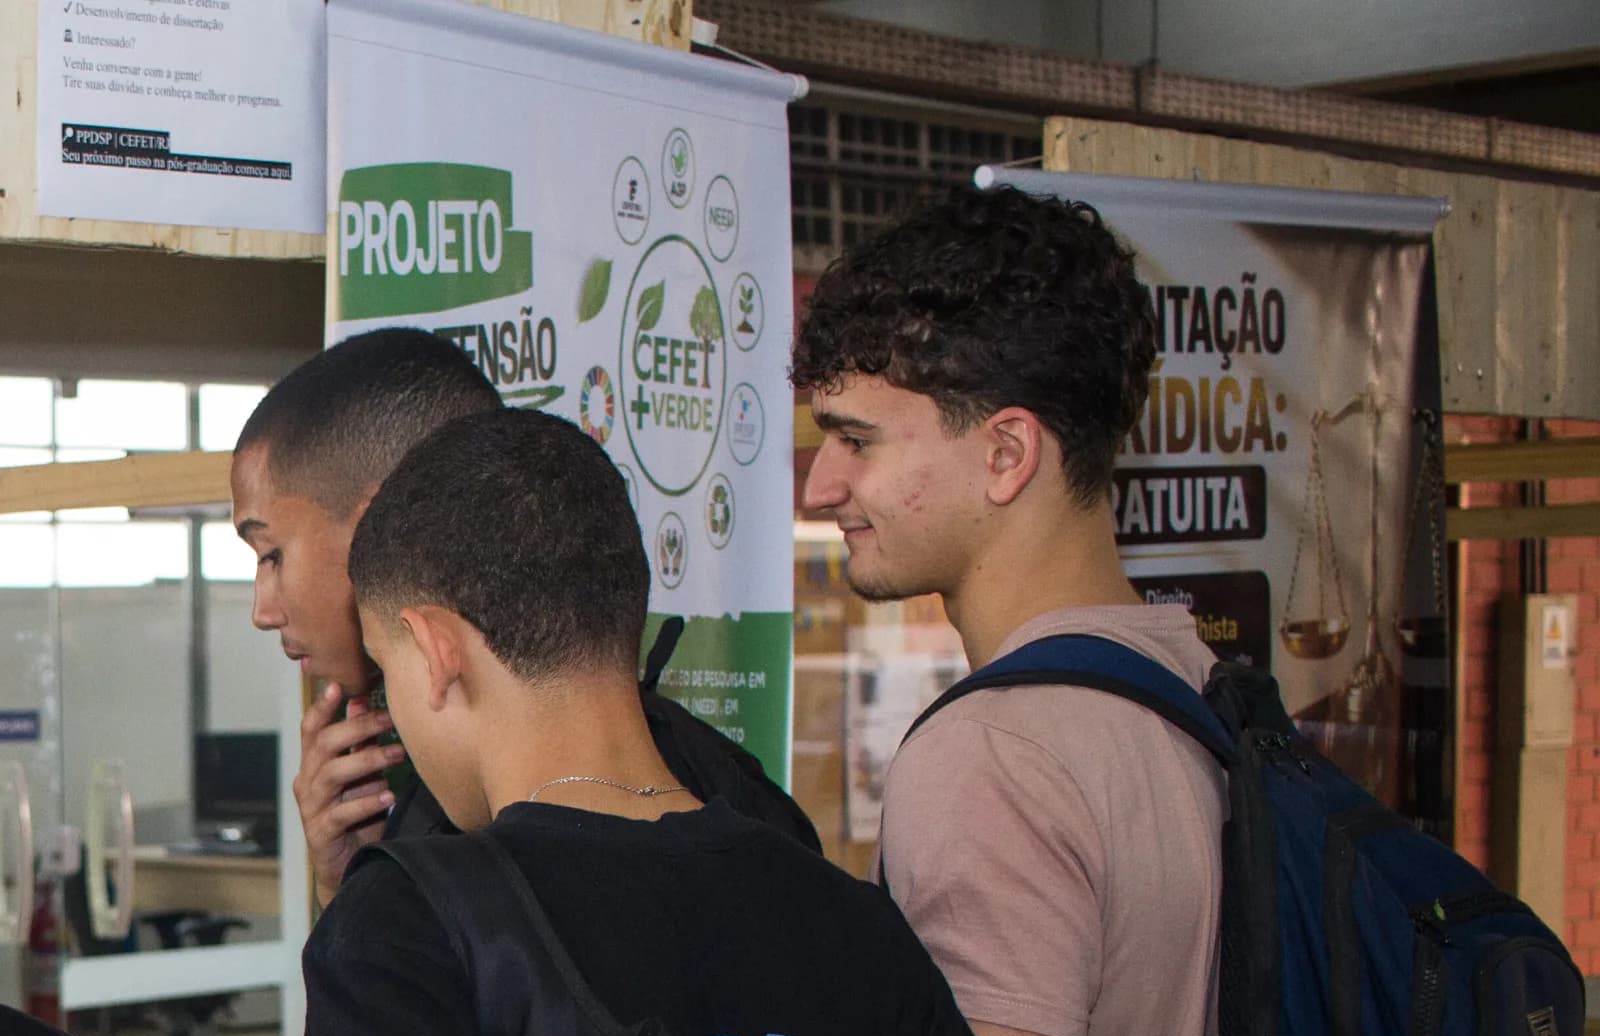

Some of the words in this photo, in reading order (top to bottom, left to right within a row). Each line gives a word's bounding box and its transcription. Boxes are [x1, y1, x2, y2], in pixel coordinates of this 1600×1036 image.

[75, 3, 157, 24] Desenvolvimento
[159, 13, 171, 25] de
[174, 15, 224, 31] dissertação
[77, 32, 136, 49] Interessado?
[63, 56, 94, 71] Venha
[96, 63, 141, 75] conversar
[144, 68, 164, 78] com
[62, 75, 83, 88] Tire
[85, 81, 106, 90] suas
[108, 79, 144, 94] dúvidas
[146, 87, 153, 95] e
[155, 85, 192, 101] conheça
[195, 88, 227, 103] melhor
[76, 129, 113, 145] PPDSP
[62, 148, 81, 161] Seu
[82, 149, 124, 166] próximo
[125, 155, 152, 169] passo
[153, 159, 165, 169] na
[167, 156, 233, 176] pós-graduação
[235, 166, 269, 178] começa
[340, 200, 502, 276] PROJETO
[632, 333, 716, 389] CEFET
[748, 671, 765, 689] EM
